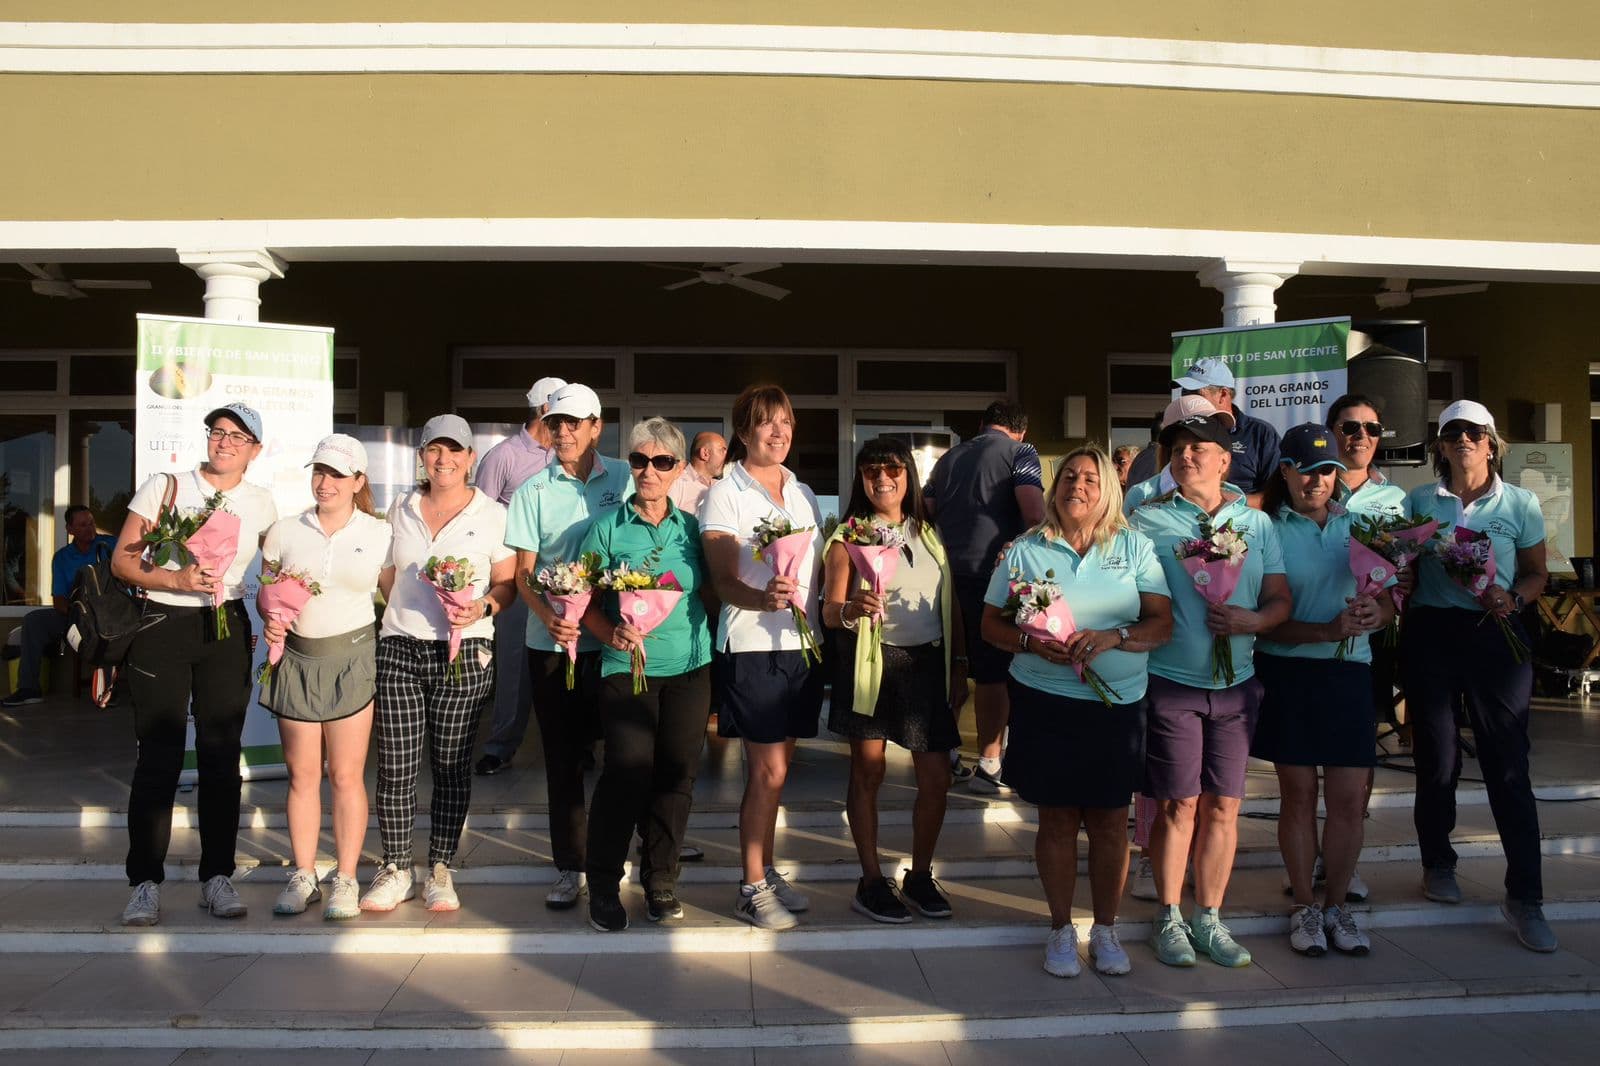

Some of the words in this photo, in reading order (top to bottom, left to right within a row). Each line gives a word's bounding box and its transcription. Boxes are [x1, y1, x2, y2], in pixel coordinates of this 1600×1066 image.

[1183, 357, 1194, 368] II
[1246, 351, 1262, 362] DE
[1263, 348, 1287, 361] SAN
[1290, 344, 1339, 359] VICENTE
[1245, 385, 1276, 396] COPA
[1279, 380, 1329, 394] GRANOS
[1250, 398, 1272, 409] DEL
[1275, 393, 1326, 408] LITORAL
